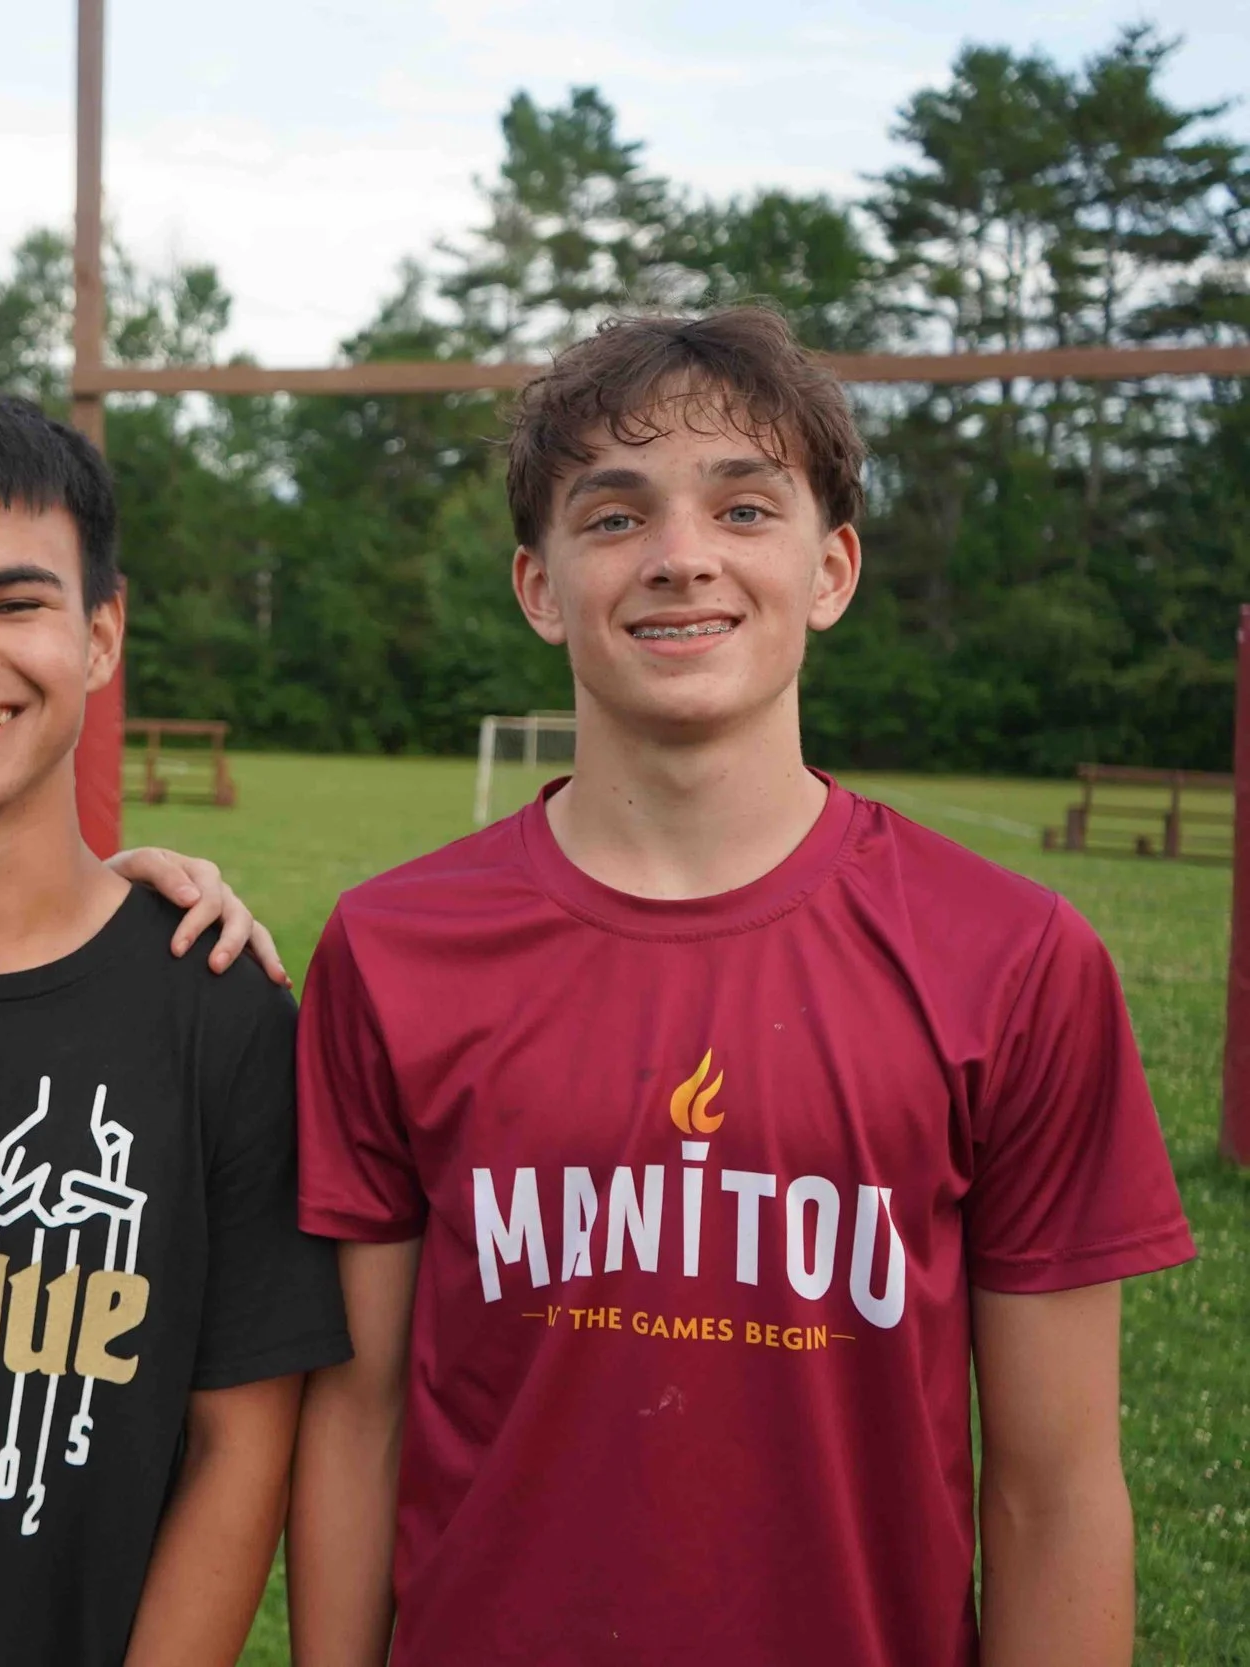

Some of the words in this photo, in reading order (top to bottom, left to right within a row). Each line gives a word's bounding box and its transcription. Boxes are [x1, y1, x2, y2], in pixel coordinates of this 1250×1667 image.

[472, 1140, 906, 1329] MANITOU
[568, 1307, 622, 1330] THE
[631, 1311, 734, 1342] GAMES
[745, 1321, 827, 1351] BEGIN
